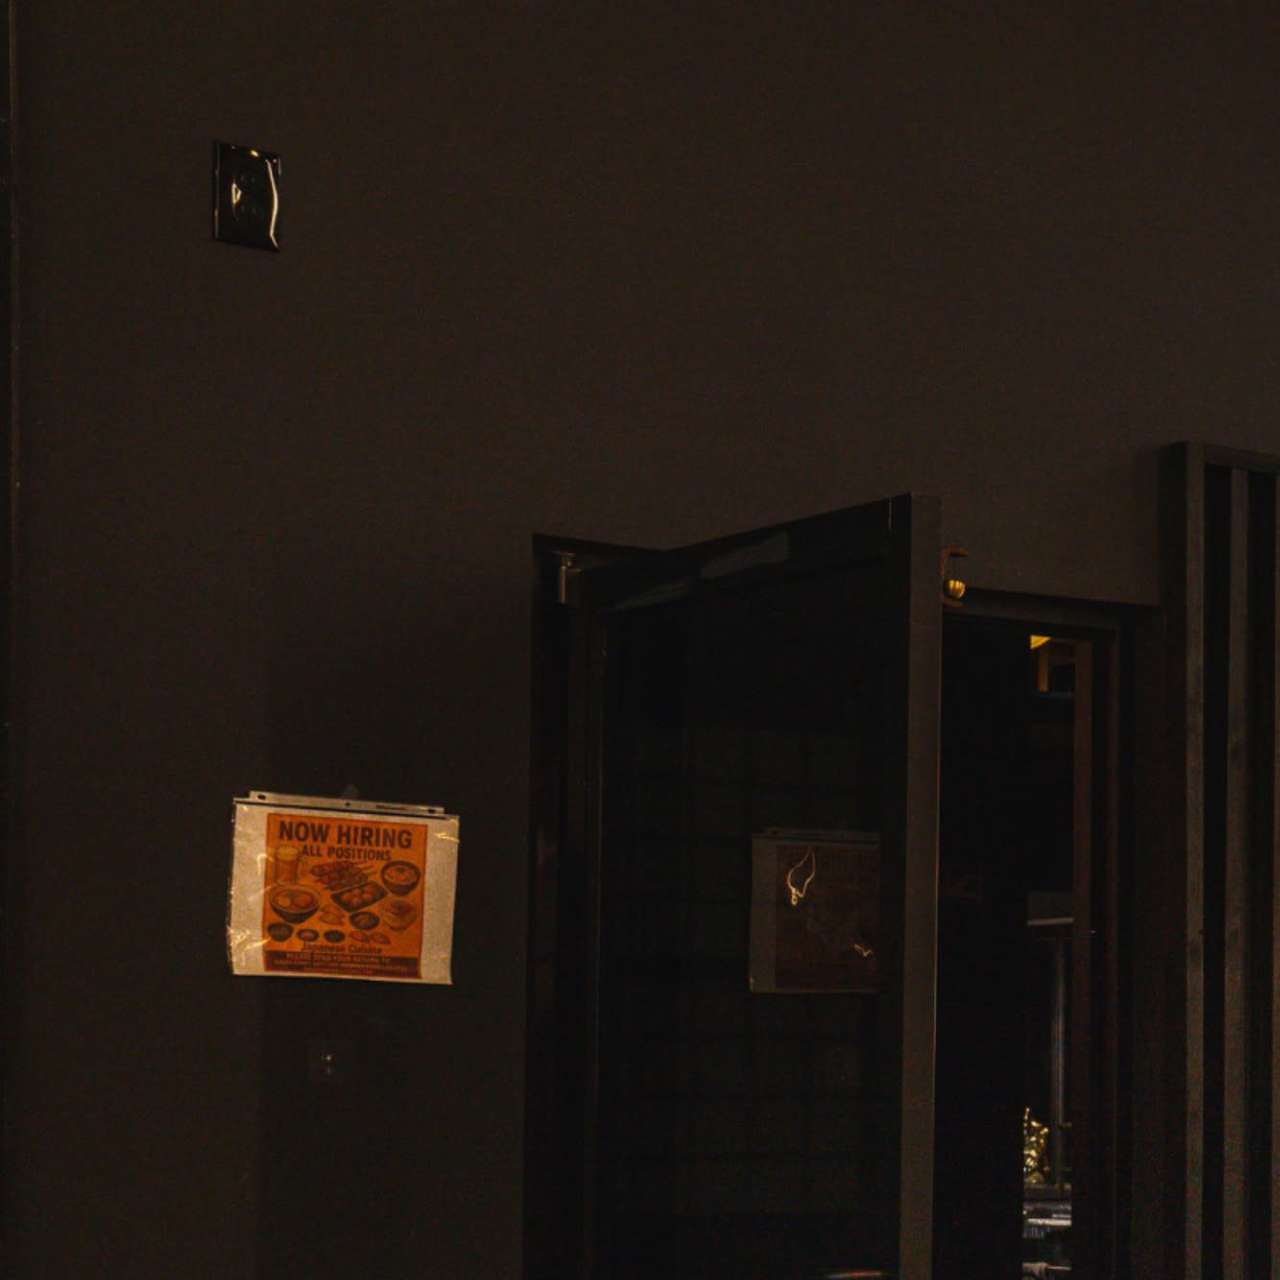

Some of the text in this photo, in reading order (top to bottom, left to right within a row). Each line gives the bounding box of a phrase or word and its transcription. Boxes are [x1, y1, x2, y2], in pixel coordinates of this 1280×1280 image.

[279, 821, 412, 849] NOW HIRING
[302, 844, 392, 861] ALL POSITIONS
